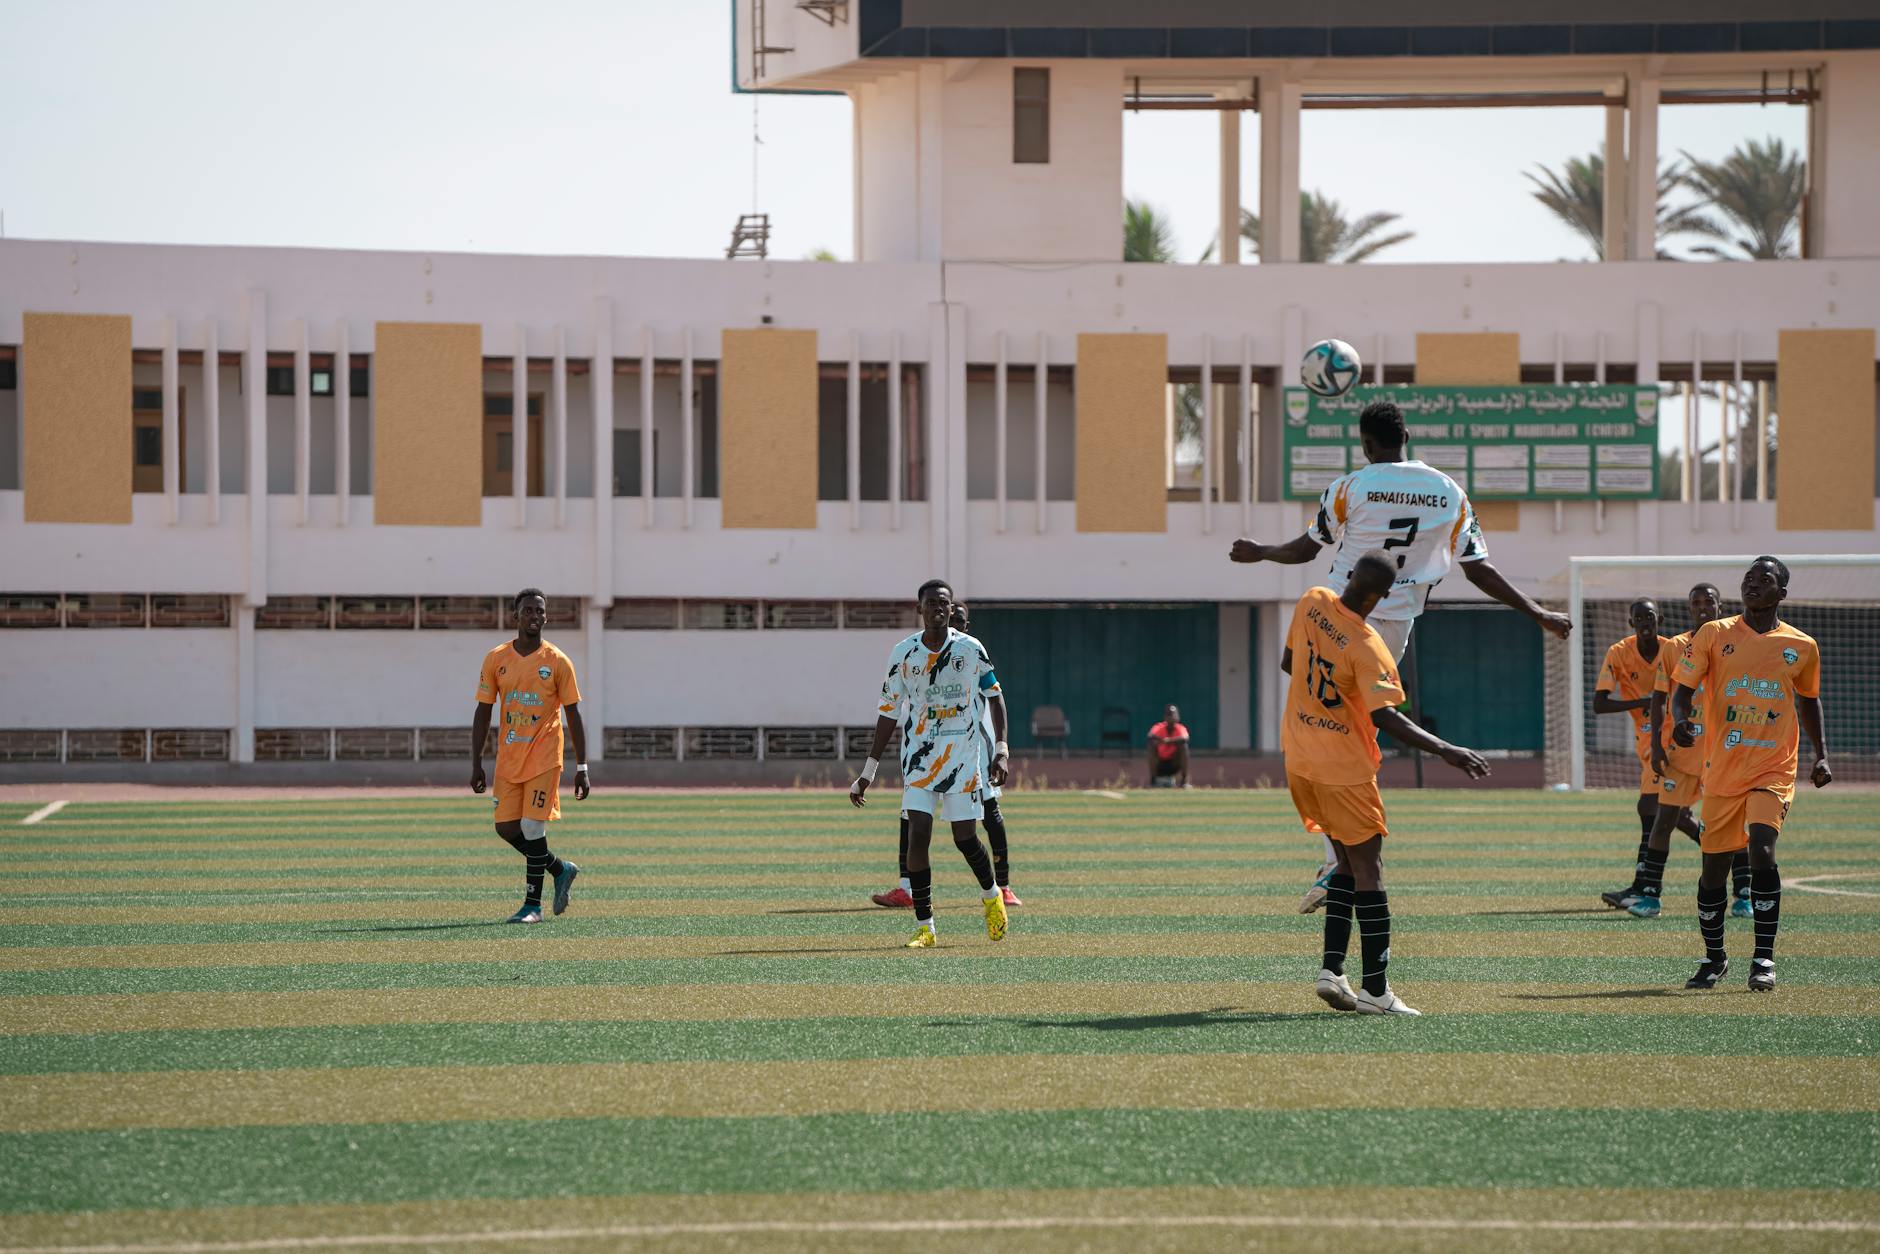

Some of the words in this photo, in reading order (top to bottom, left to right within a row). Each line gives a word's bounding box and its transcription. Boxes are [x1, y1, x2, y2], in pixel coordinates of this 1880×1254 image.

[1367, 491, 1438, 507] RENAISSANCE
[1440, 496, 1448, 508] G
[532, 790, 546, 808] 15
